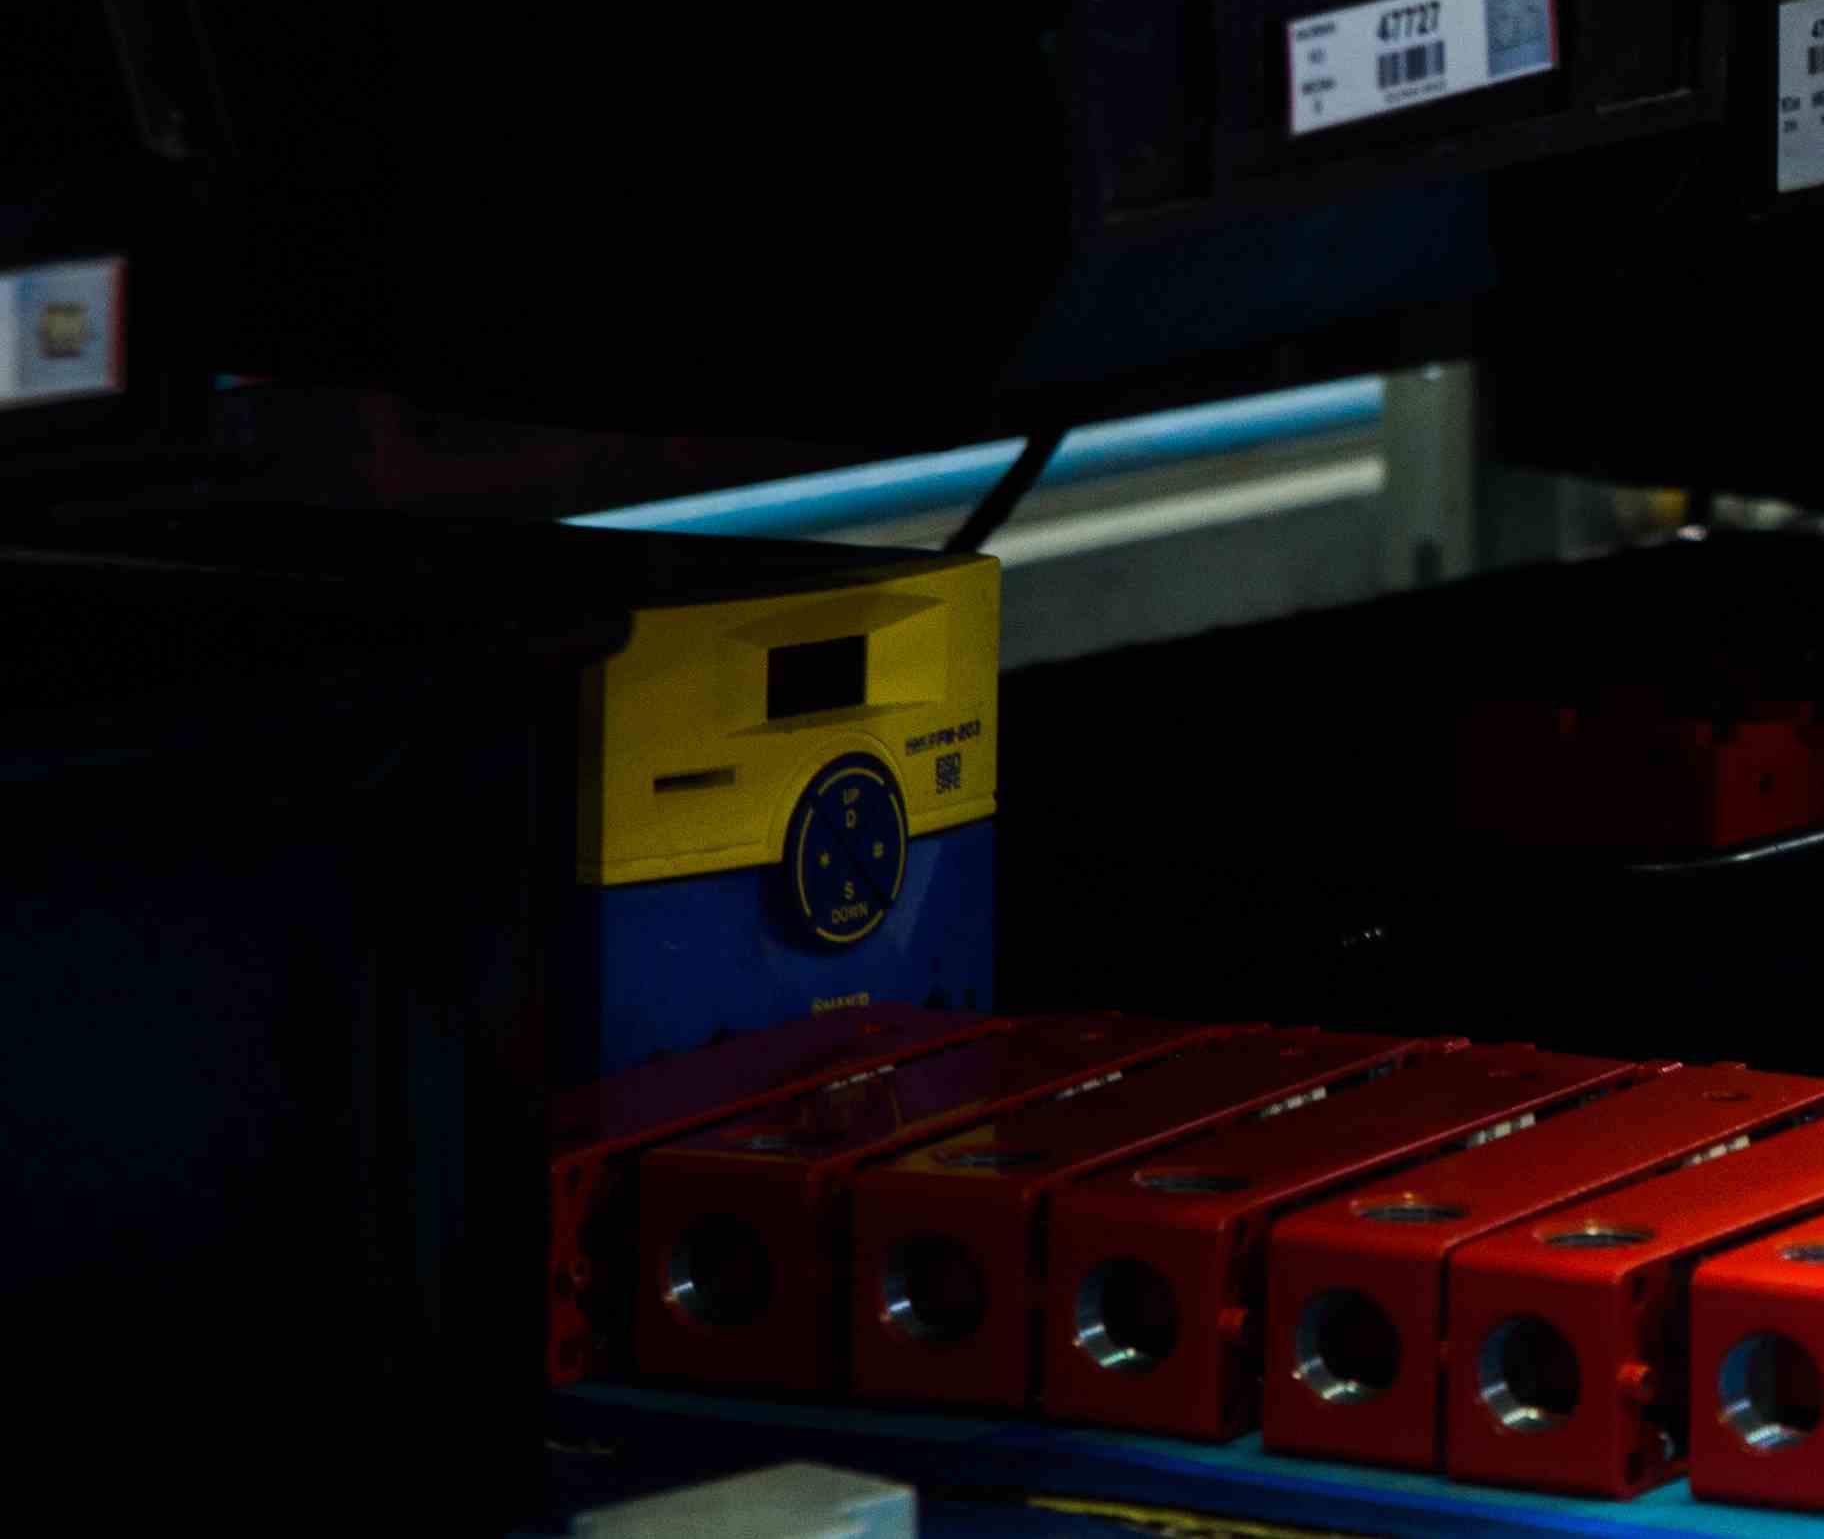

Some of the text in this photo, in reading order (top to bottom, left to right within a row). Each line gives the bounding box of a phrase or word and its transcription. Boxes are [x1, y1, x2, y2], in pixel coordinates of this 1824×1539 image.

[1377, 0, 1441, 42] 47727
[843, 787, 861, 805] UP
[831, 902, 869, 925] DOWN
